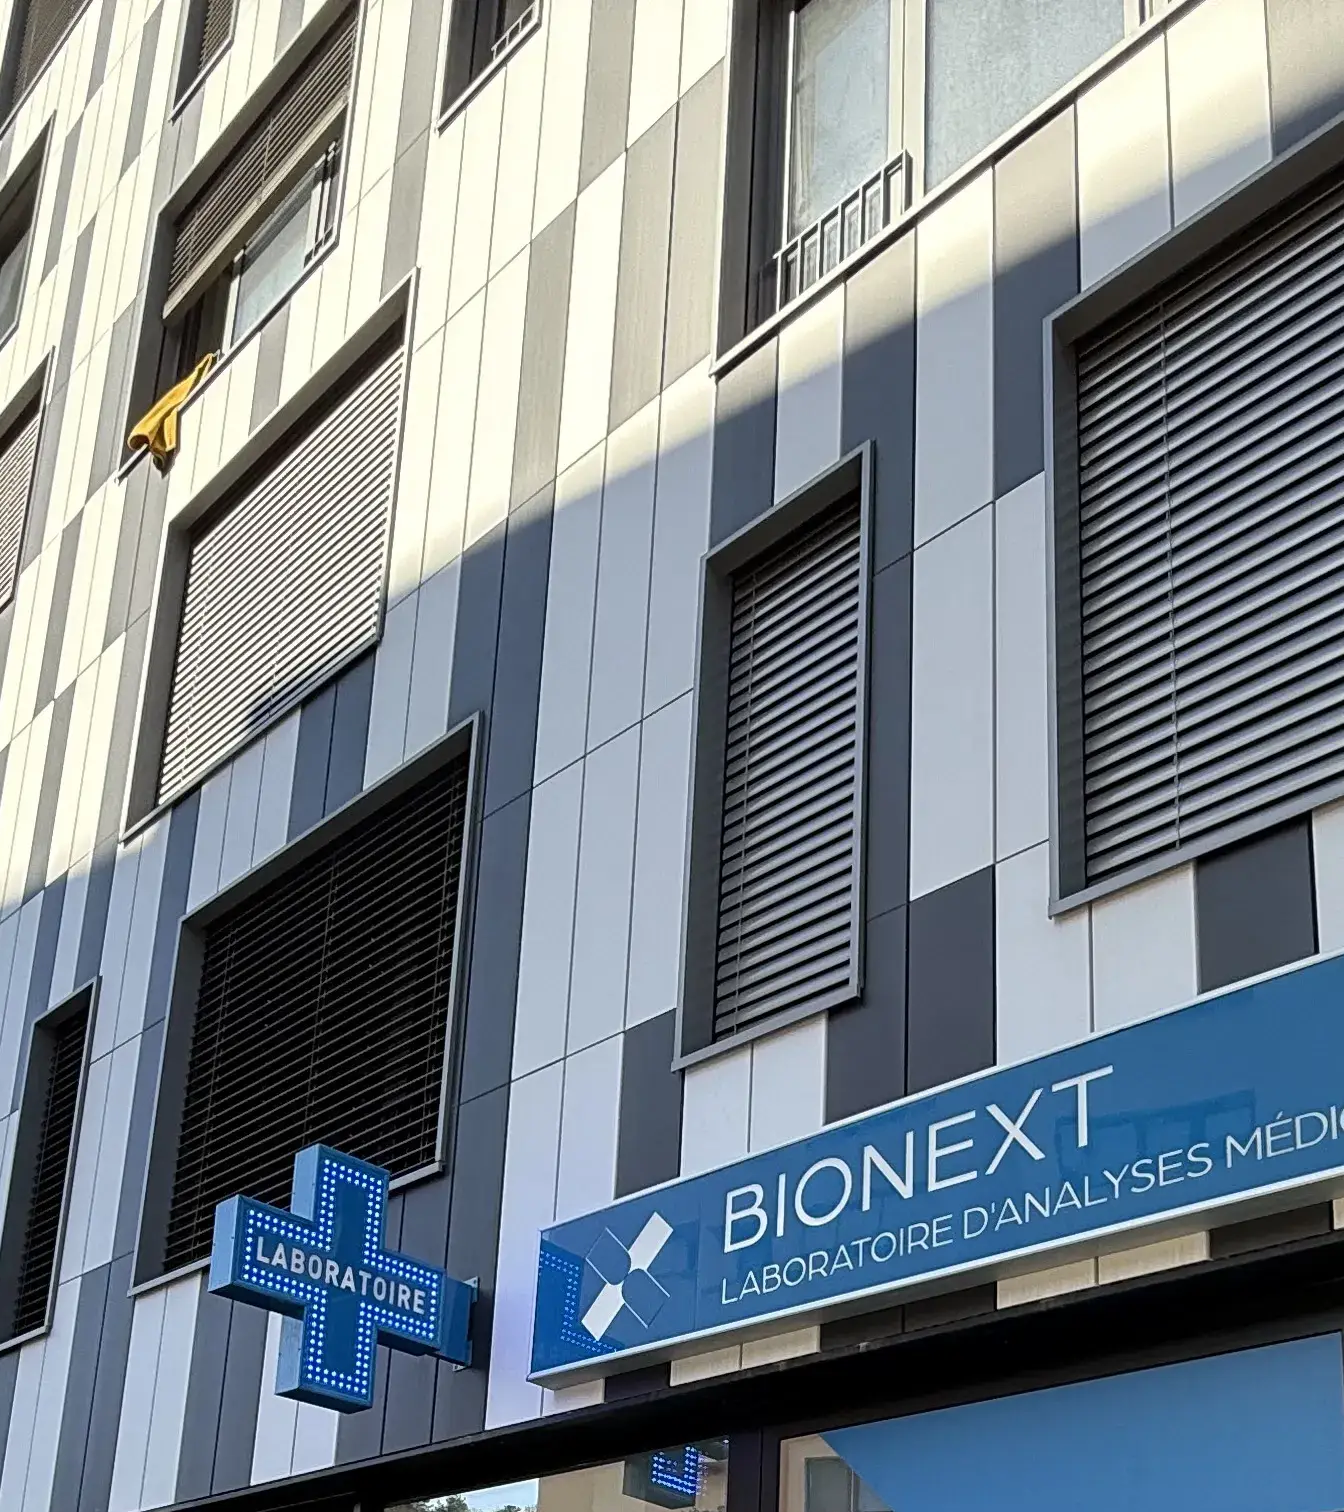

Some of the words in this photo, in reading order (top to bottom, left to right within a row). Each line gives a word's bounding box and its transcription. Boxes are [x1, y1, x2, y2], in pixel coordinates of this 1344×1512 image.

[721, 1213, 954, 1305] LABORATOIRE
[963, 1142, 1213, 1240] D'ANALYSES
[723, 1065, 1114, 1254] BIONEXT
[255, 1236, 427, 1315] LABORATOIRE
